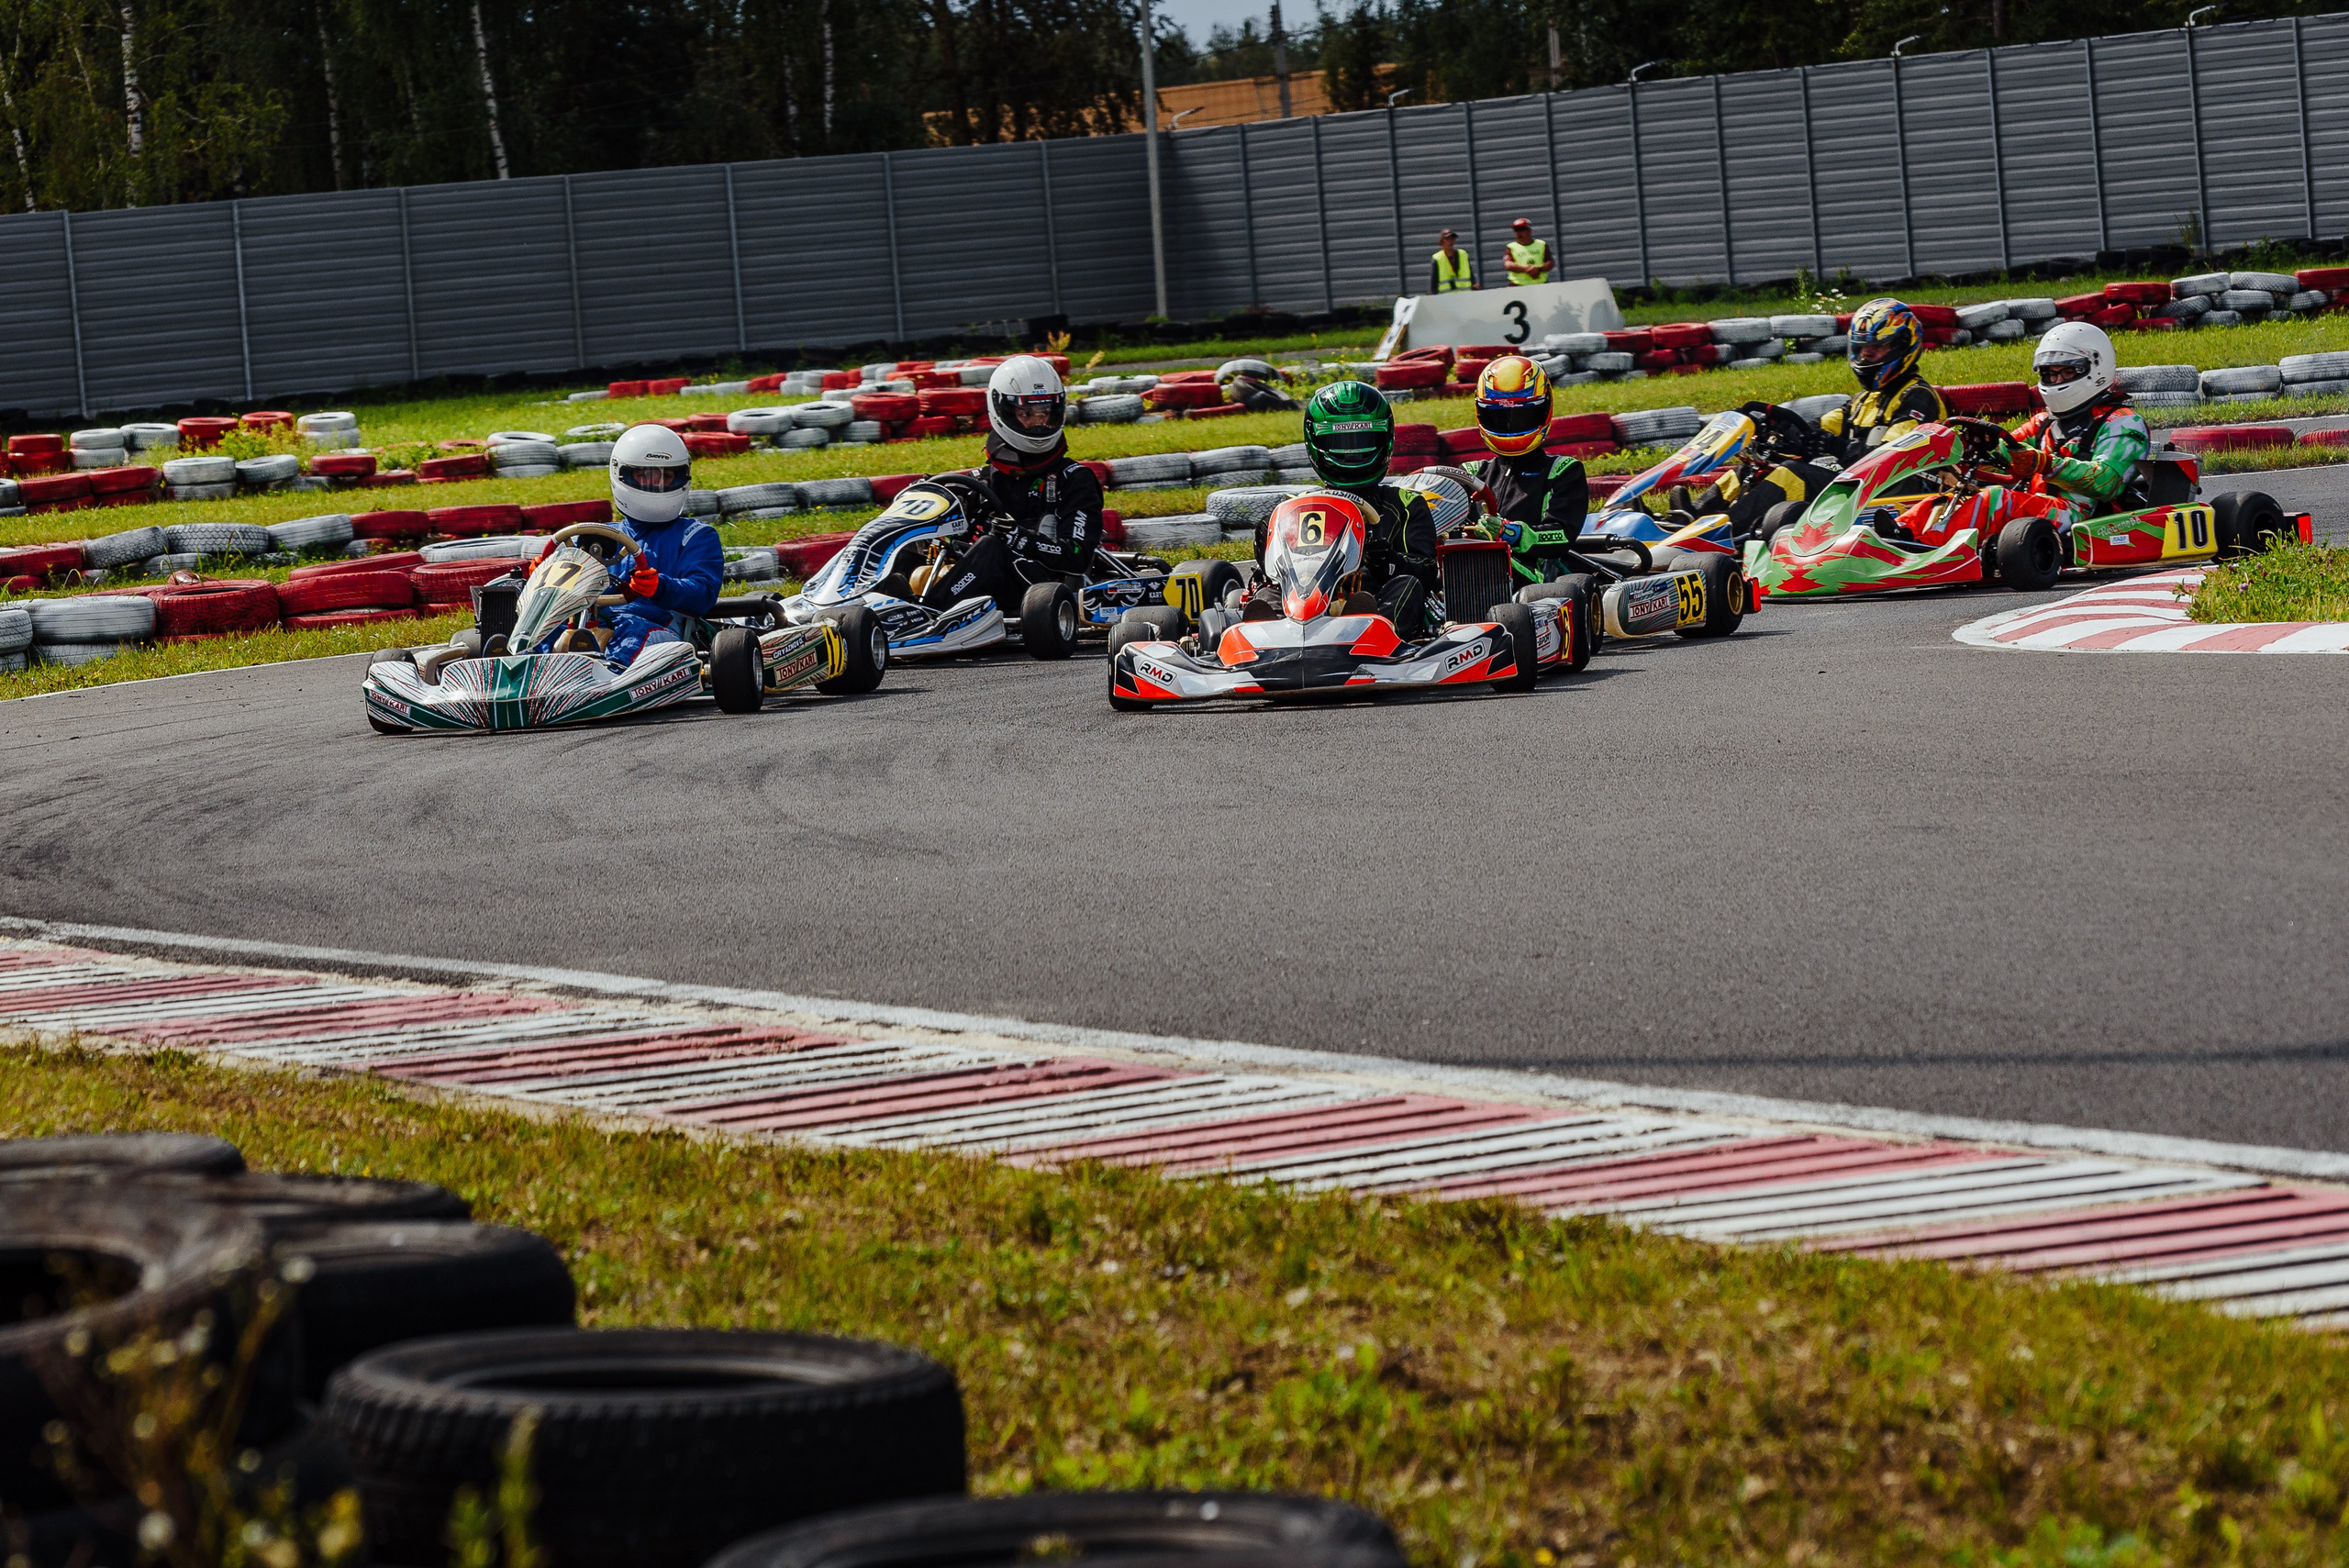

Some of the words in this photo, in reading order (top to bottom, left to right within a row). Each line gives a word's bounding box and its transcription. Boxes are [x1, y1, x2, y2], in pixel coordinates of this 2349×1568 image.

[1504, 300, 1531, 344] 3
[890, 499, 936, 516] 70
[1072, 510, 1087, 540] TEAM
[1300, 512, 1321, 545] 6
[1538, 532, 1564, 542] sparco
[2174, 509, 2209, 550] 10
[1035, 541, 1062, 554] parco
[534, 562, 583, 590] 17
[951, 572, 976, 595] sparco
[1175, 577, 1200, 620] 70
[1629, 602, 1651, 618] TONY
[1652, 595, 1669, 612] KART
[1677, 573, 1703, 621] 55
[1563, 609, 1570, 657] 6
[826, 626, 843, 675] 17
[1447, 644, 1483, 670] RMD
[776, 662, 796, 683] TONY
[798, 651, 818, 671] KART
[1140, 662, 1174, 683] RMD
[630, 683, 657, 700] TONY
[660, 667, 690, 688] KART
[370, 689, 386, 706] TONY
[387, 698, 410, 716] KART
